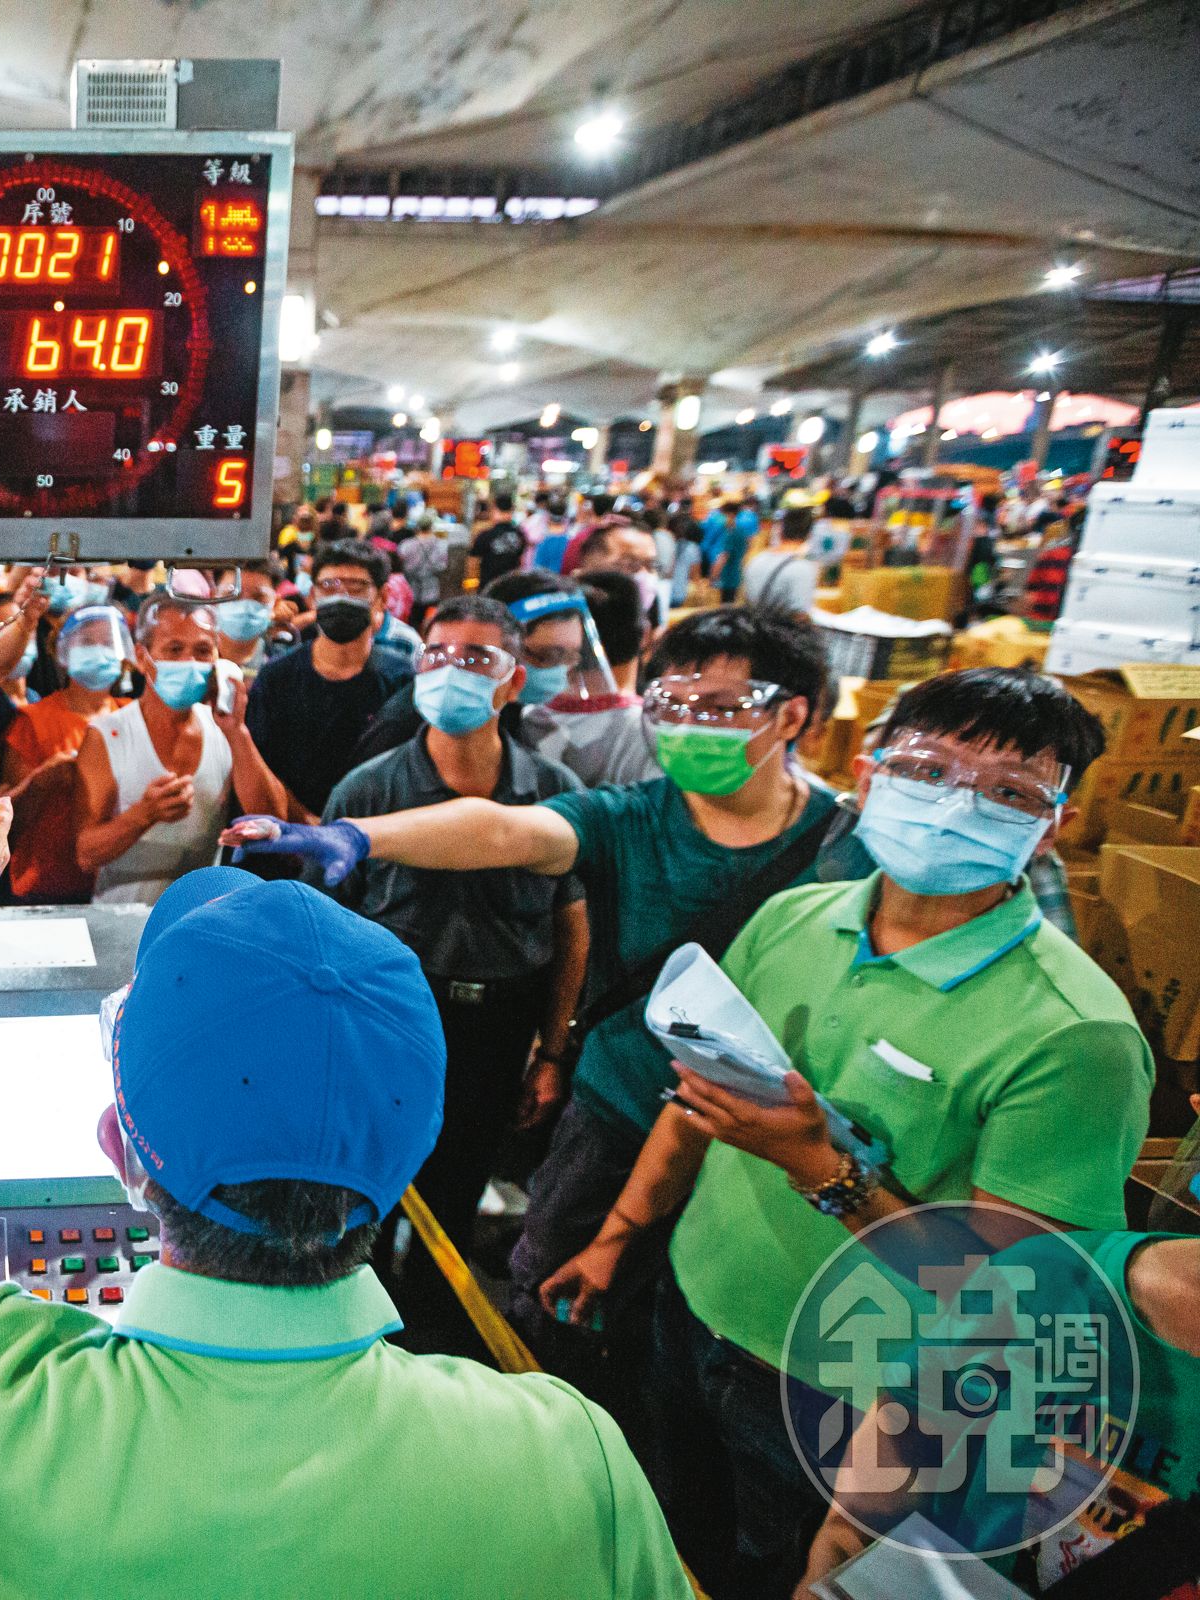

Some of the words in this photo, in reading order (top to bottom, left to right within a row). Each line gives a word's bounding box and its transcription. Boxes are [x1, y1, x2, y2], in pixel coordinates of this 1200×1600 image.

[201, 158, 253, 187] 等級
[37, 187, 56, 202] 00
[21, 199, 74, 226] 序號
[118, 217, 135, 233] 10
[163, 291, 182, 307] 20
[160, 381, 179, 396] 30
[2, 387, 88, 414] 承銷人
[193, 424, 248, 450] 重量
[112, 448, 131, 461] 40
[36, 474, 54, 488] 50
[216, 461, 246, 504] 5
